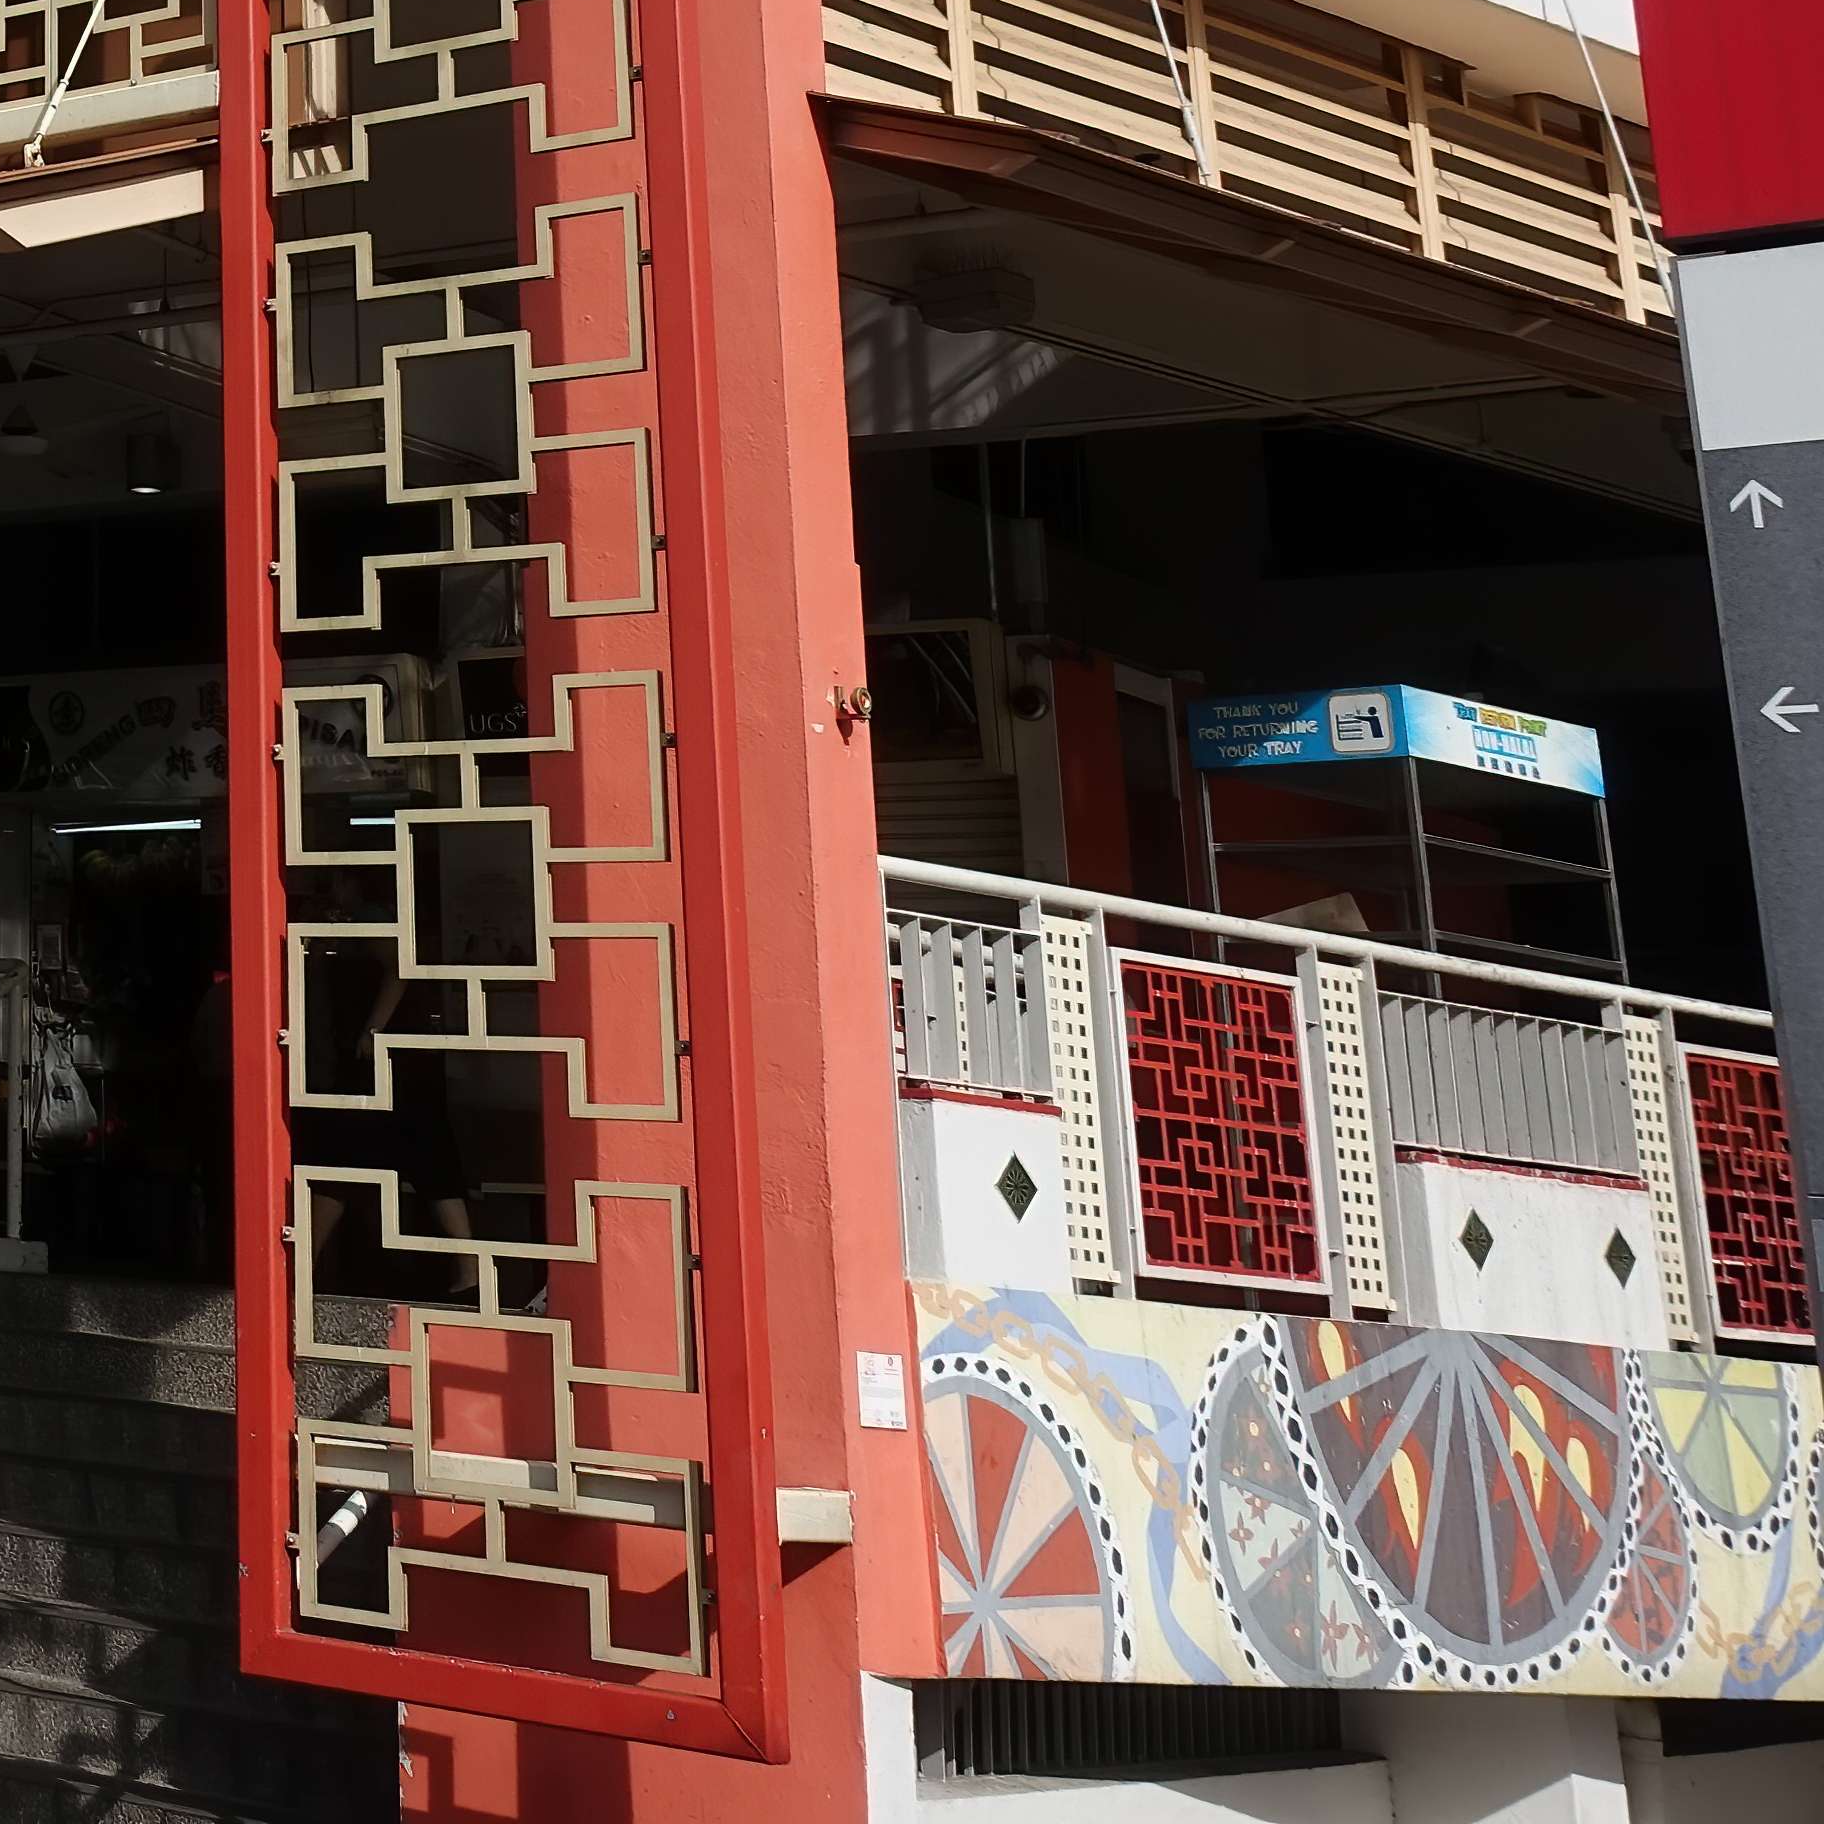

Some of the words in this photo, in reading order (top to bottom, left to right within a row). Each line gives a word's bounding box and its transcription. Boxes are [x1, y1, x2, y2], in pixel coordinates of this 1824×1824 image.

[1213, 704, 1262, 720] THANK
[1269, 701, 1298, 716] YOU
[1197, 726, 1226, 741] FOR
[1233, 720, 1321, 738] RETURNING
[1218, 743, 1259, 759] YOUR
[1263, 740, 1303, 756] TRAY
